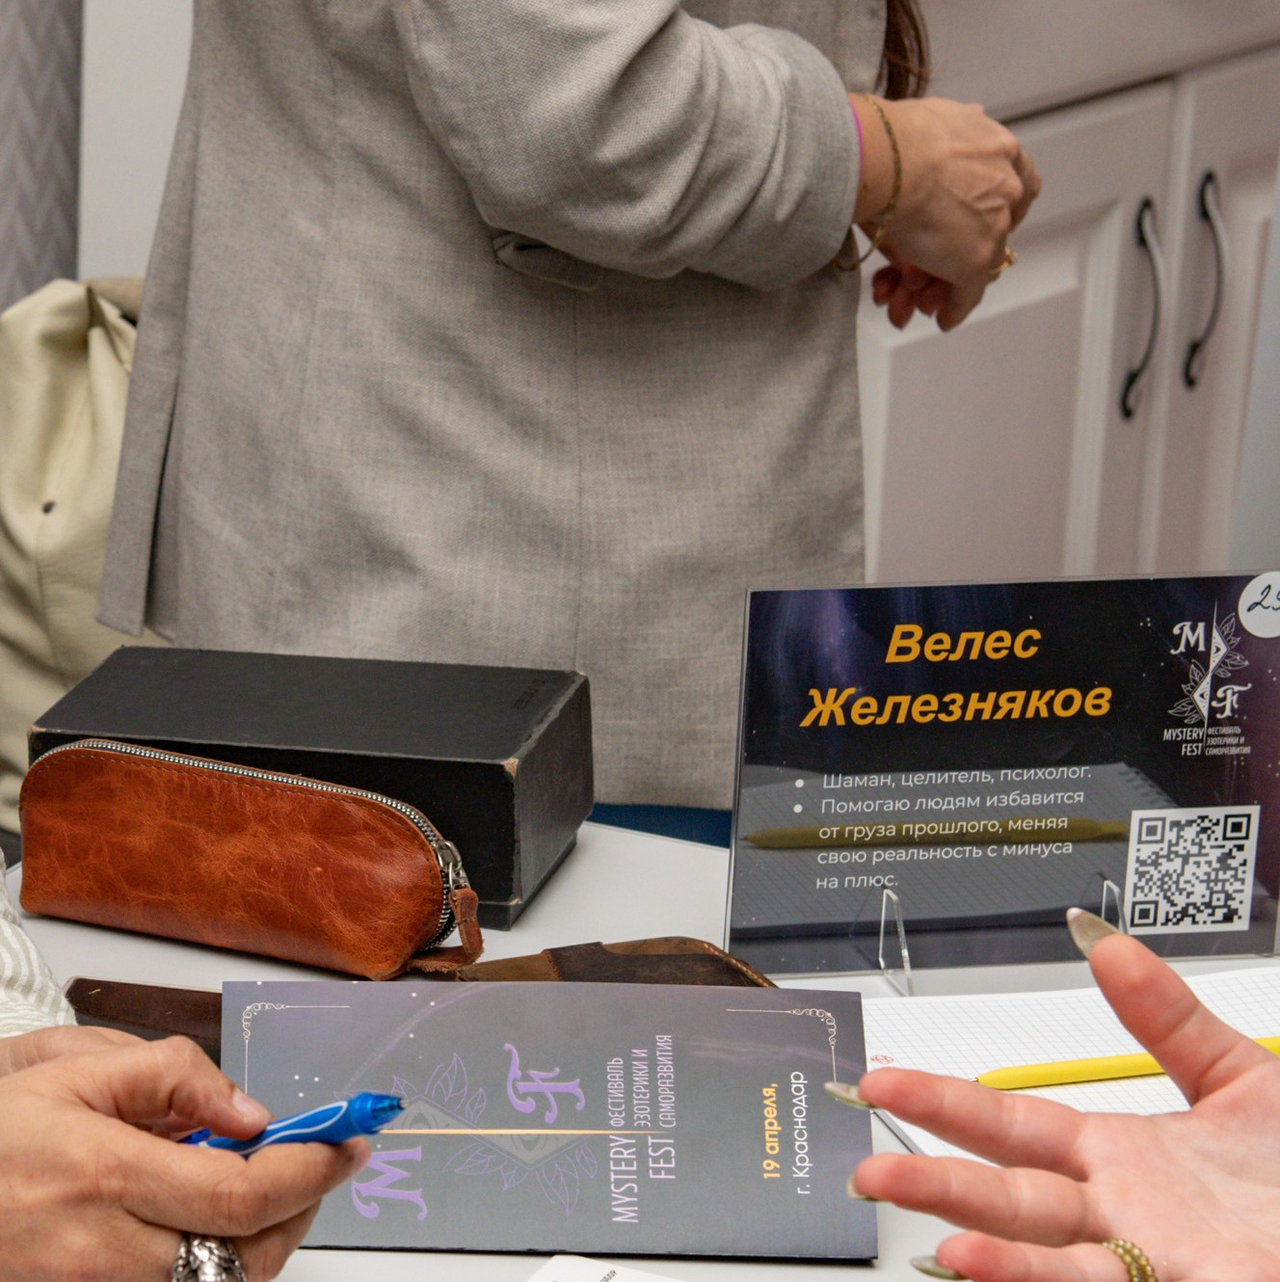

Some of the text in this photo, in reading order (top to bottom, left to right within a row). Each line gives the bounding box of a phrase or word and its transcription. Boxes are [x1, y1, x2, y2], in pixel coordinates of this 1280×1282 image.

[885, 624, 1042, 663] Велес
[1170, 622, 1206, 655] M
[799, 687, 1112, 727] Железняков
[1163, 728, 1205, 741] MYSTERY
[1181, 743, 1203, 756] FEST
[823, 765, 1091, 788] Шаман, целитель, психолог.
[821, 790, 1084, 814] Помогаю людям избавится
[819, 817, 1068, 841] от груза прошлого, меняя
[817, 841, 1073, 865] свою реальность с минуса
[816, 873, 899, 889] на плюс.
[607, 1057, 625, 1127] ФЕСТИВАЛЬ
[631, 1049, 651, 1127] ЭЗОТЕРИКИ И
[655, 1034, 676, 1128] САМОРАЗВИТИЯ
[762, 1083, 782, 1179] 19 апреля,
[790, 1071, 813, 1194] г. Краснодар
[648, 1136, 676, 1179] FEST
[609, 1135, 639, 1223] MYSTERY
